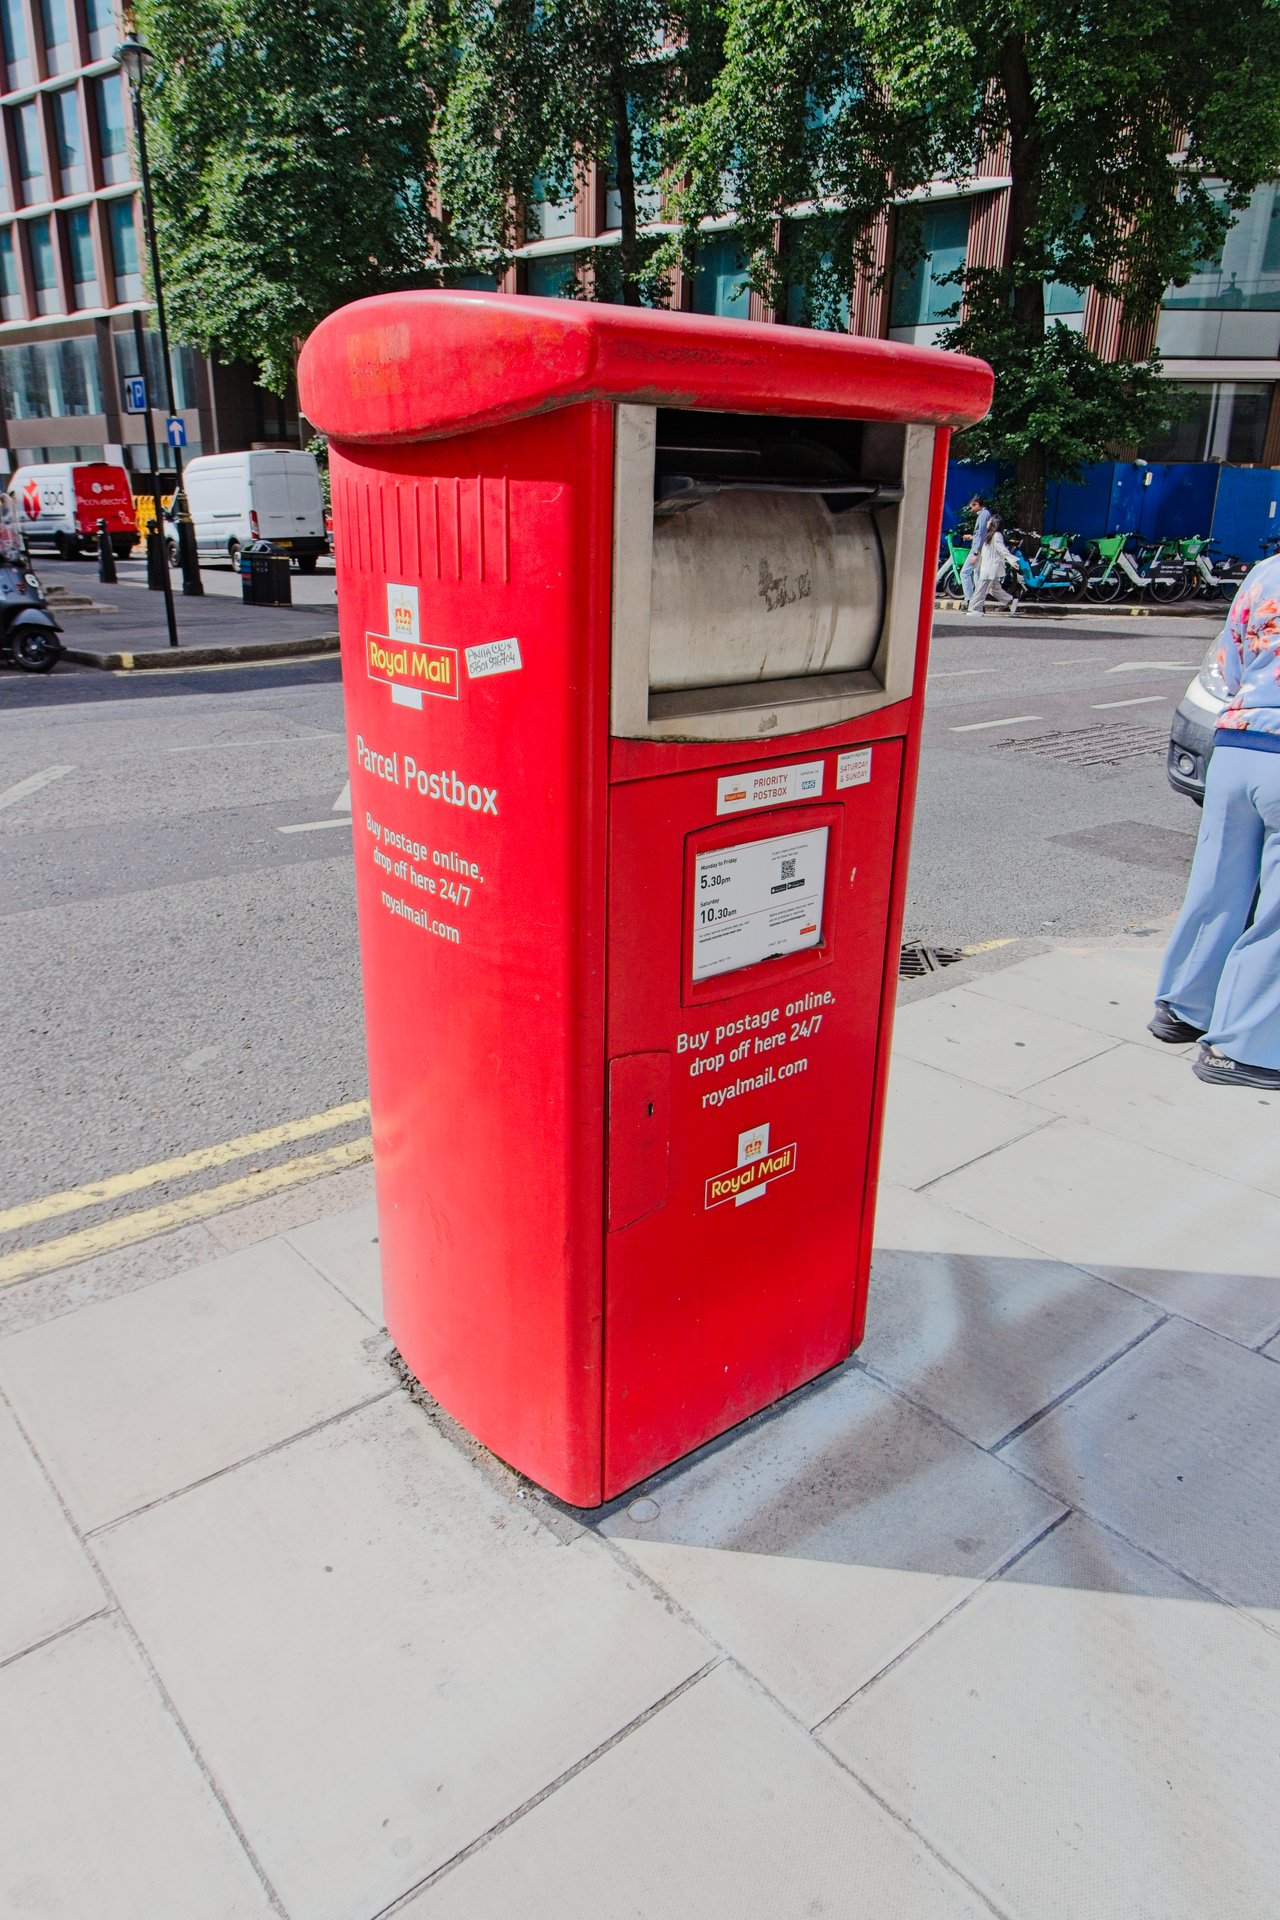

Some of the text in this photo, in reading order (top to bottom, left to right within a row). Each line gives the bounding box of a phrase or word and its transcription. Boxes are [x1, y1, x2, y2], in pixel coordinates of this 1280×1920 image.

[134, 384, 142, 406] P
[370, 641, 450, 684] Royal Mail
[357, 734, 498, 816] Parcel Postbox
[840, 761, 868, 773] SATURDAY
[845, 770, 868, 781] SUNDAY
[753, 774, 788, 788] PRIORITY
[802, 780, 815, 790] NHS
[753, 787, 787, 801] POSTBOX
[366, 811, 484, 883] Buy postage online,
[700, 862, 718, 871] Monday
[723, 858, 738, 866] Friday
[373, 846, 471, 907] drop off here 24/7
[700, 874, 731, 889] 5.30pm
[700, 899, 720, 907] Saturday
[381, 890, 460, 944] royalmail.com
[700, 907, 737, 924] 10.30am
[676, 990, 836, 1054] Buy postage online,
[689, 1014, 823, 1077] drop off here 24/7
[1204, 1055, 1236, 1070] HOKA
[702, 1057, 808, 1109] royalmail.com
[711, 1150, 790, 1199] Royal Mail
